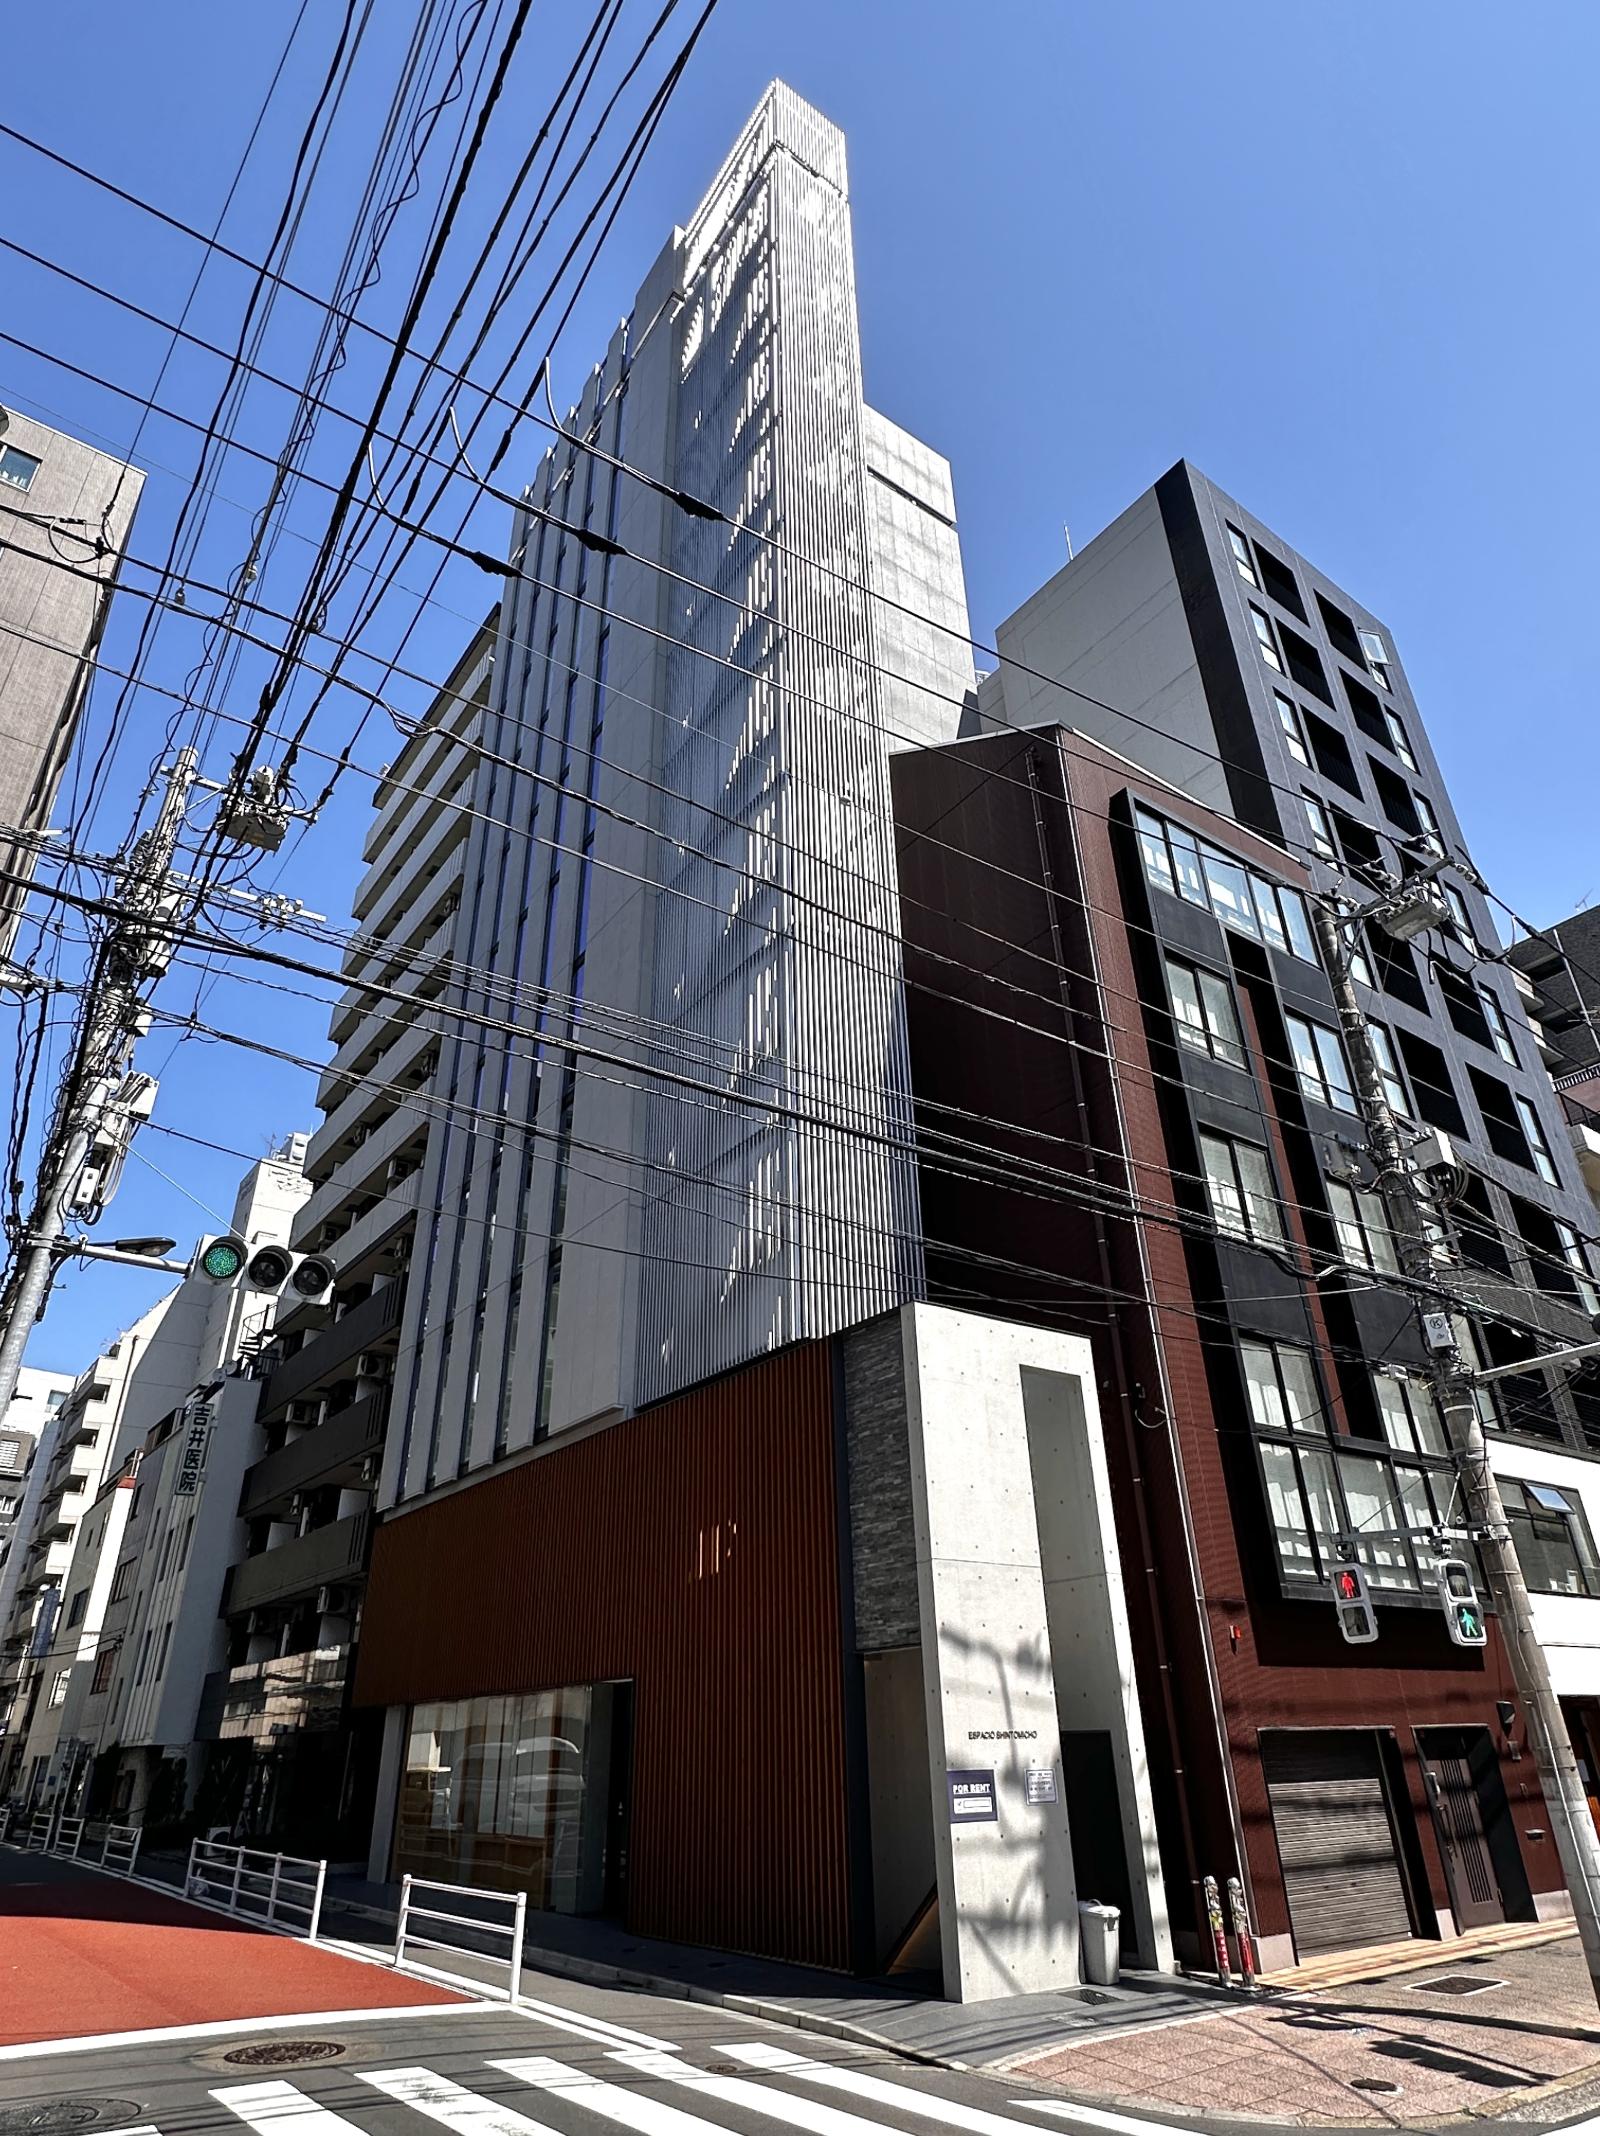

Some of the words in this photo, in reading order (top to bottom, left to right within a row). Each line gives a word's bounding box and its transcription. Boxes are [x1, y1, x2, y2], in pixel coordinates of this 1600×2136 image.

[179, 1406, 211, 1492] 吉井医院
[968, 1731, 995, 1740] ESPACIO
[953, 1784, 969, 1795] FOR
[970, 1783, 991, 1794] RENT
